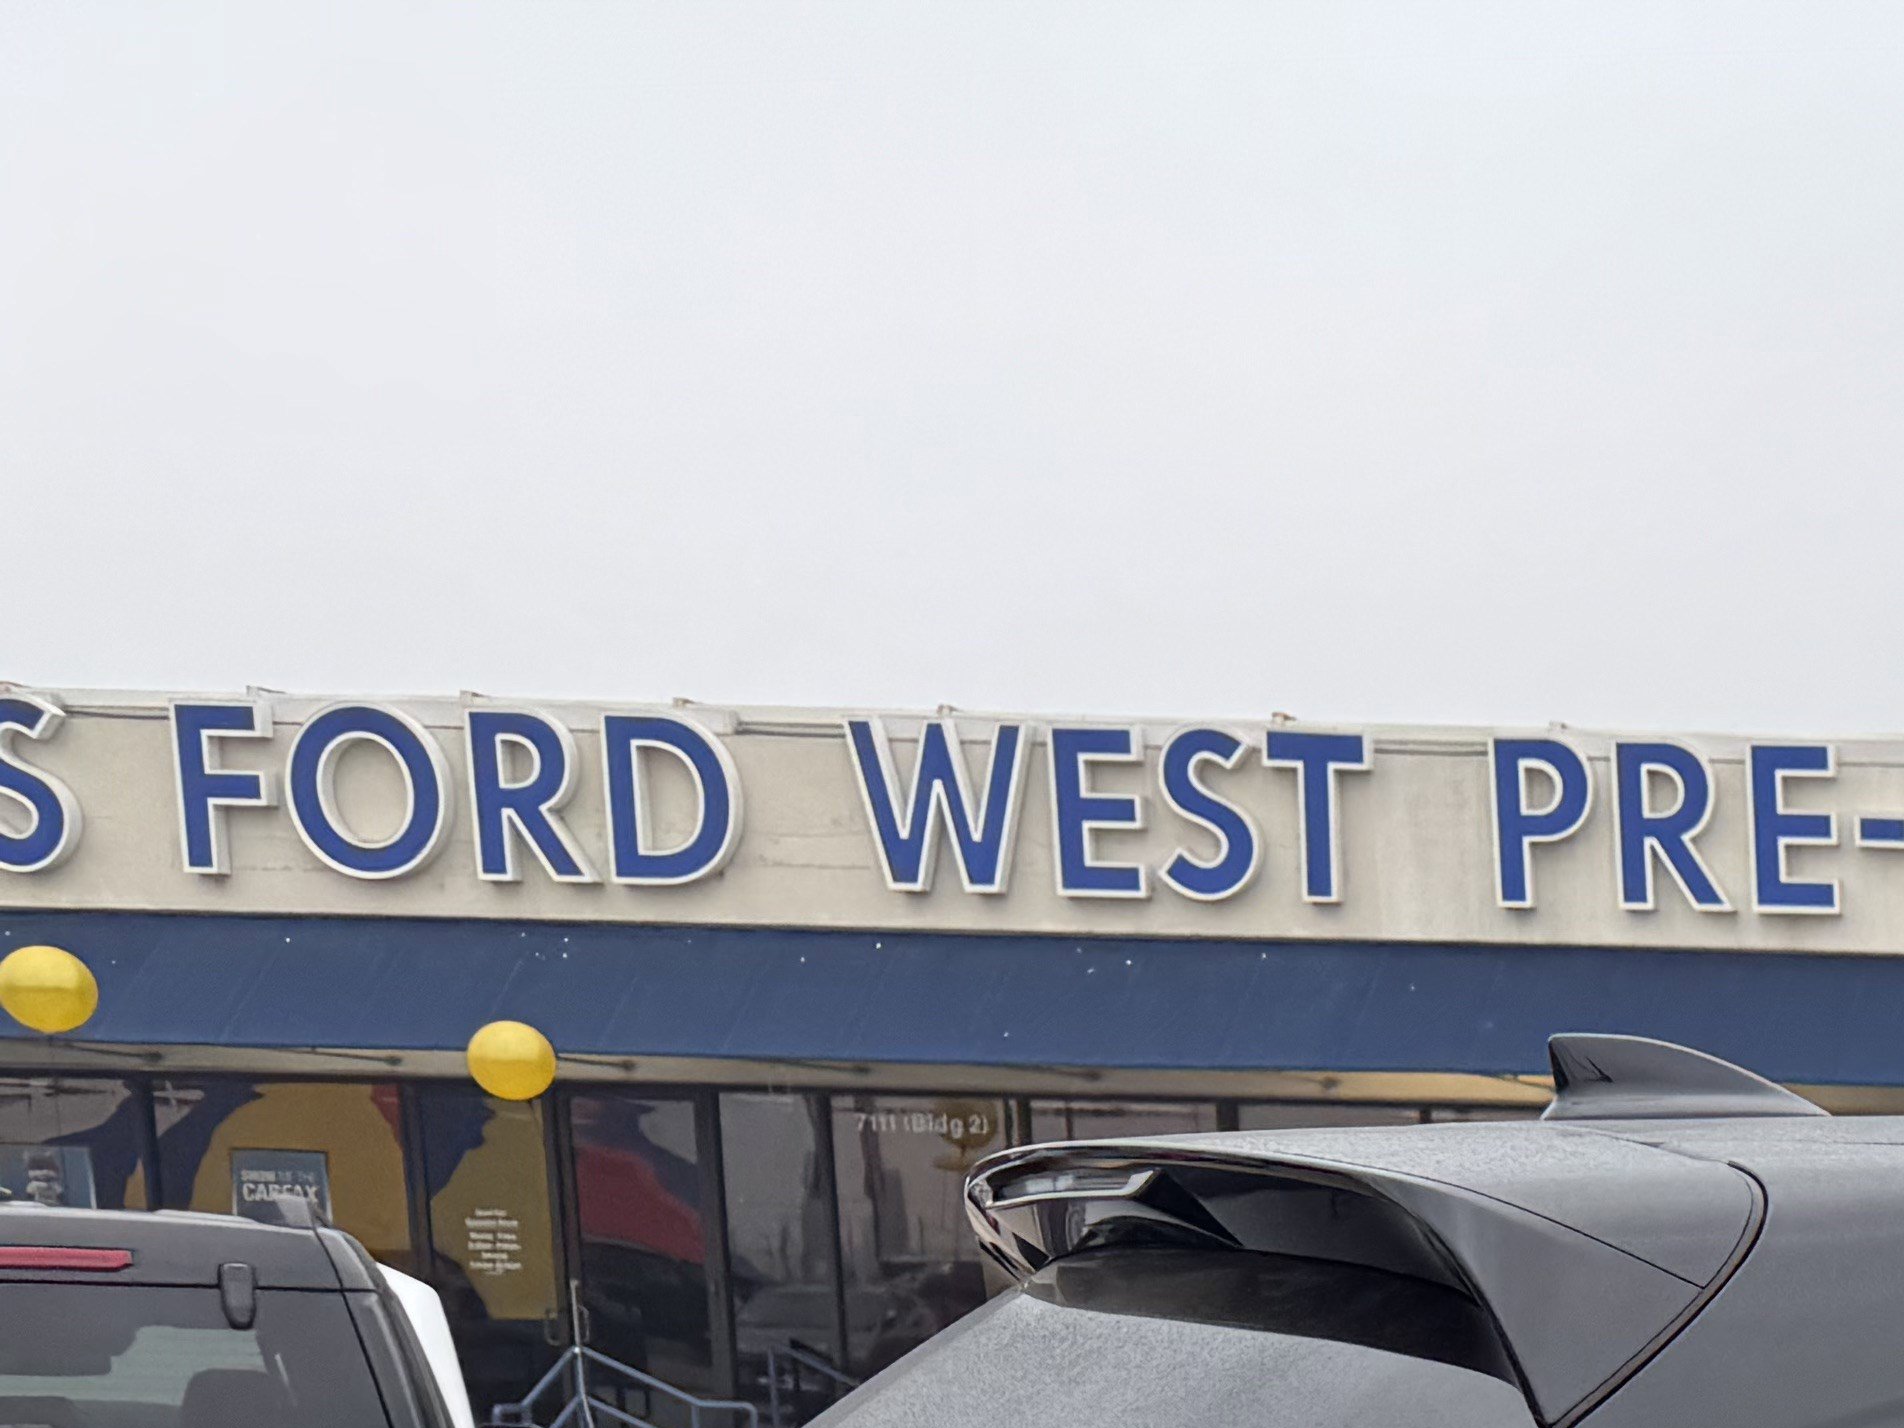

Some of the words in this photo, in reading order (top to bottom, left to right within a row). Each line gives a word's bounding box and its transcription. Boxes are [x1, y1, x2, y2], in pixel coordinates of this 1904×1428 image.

[170, 698, 744, 887] FORD
[842, 714, 1374, 904] WEST
[853, 1112, 896, 1132] 7111
[968, 1113, 989, 1135] 2)
